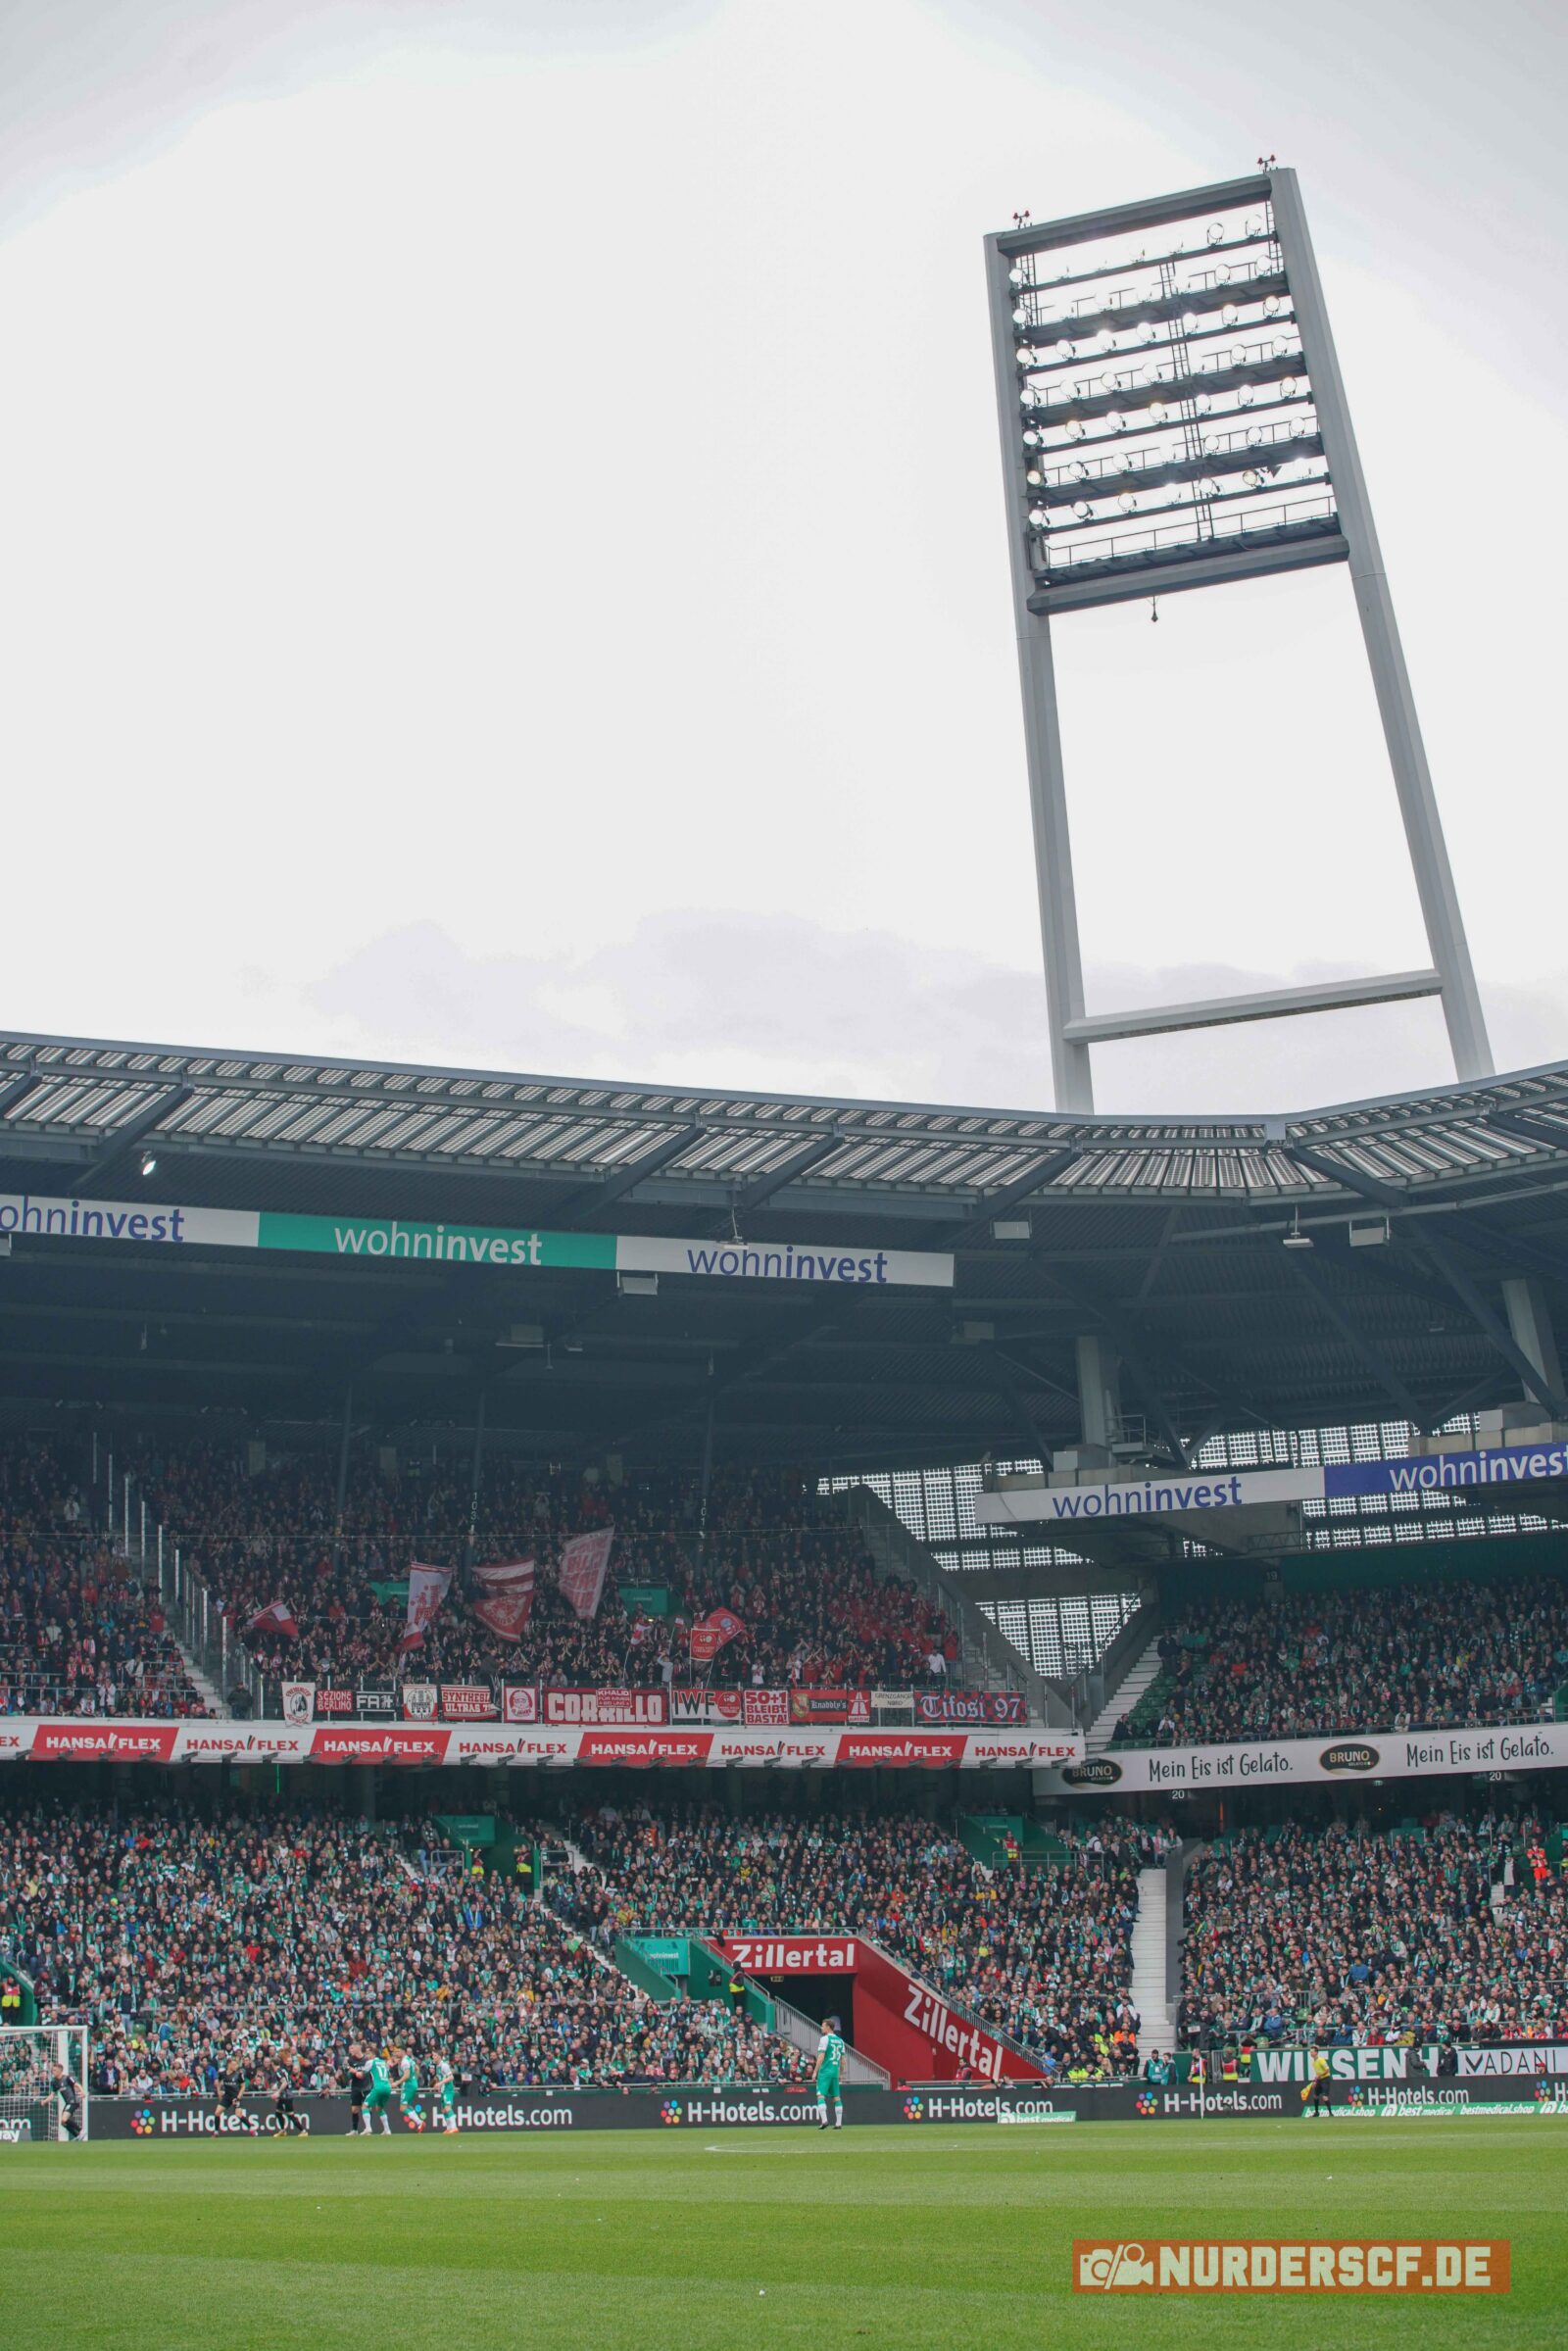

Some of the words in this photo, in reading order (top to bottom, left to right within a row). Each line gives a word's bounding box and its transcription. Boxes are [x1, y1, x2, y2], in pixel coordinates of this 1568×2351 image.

[334, 1221, 542, 1266] wohninvest
[687, 1243, 887, 1284] wohninvest
[1052, 1476, 1243, 1518] wohninvest
[746, 1691, 787, 1704] 50+1
[921, 1694, 985, 1718] Tifosi
[995, 1697, 1020, 1719] 97
[1329, 1750, 1370, 1763] BRUNO
[1406, 1742, 1444, 1768] Mein
[1450, 1740, 1471, 1764] Eis
[1477, 1739, 1495, 1760] ist
[1500, 1735, 1554, 1761] Gelato.
[1149, 1757, 1186, 1783] Mein
[1192, 1756, 1211, 1780] Eis
[1217, 1754, 1235, 1776] ist
[1240, 1751, 1294, 1776] Gelato.
[1489, 1771, 1502, 1781] 20
[1171, 1789, 1185, 1799] 20
[732, 1942, 855, 1968] Zillertal
[904, 1984, 1004, 2081] Zillertal
[1368, 2084, 1469, 2106] H-Hotels.com
[432, 2105, 572, 2127] HHotels.com
[688, 2101, 820, 2122] H-Hotels.com
